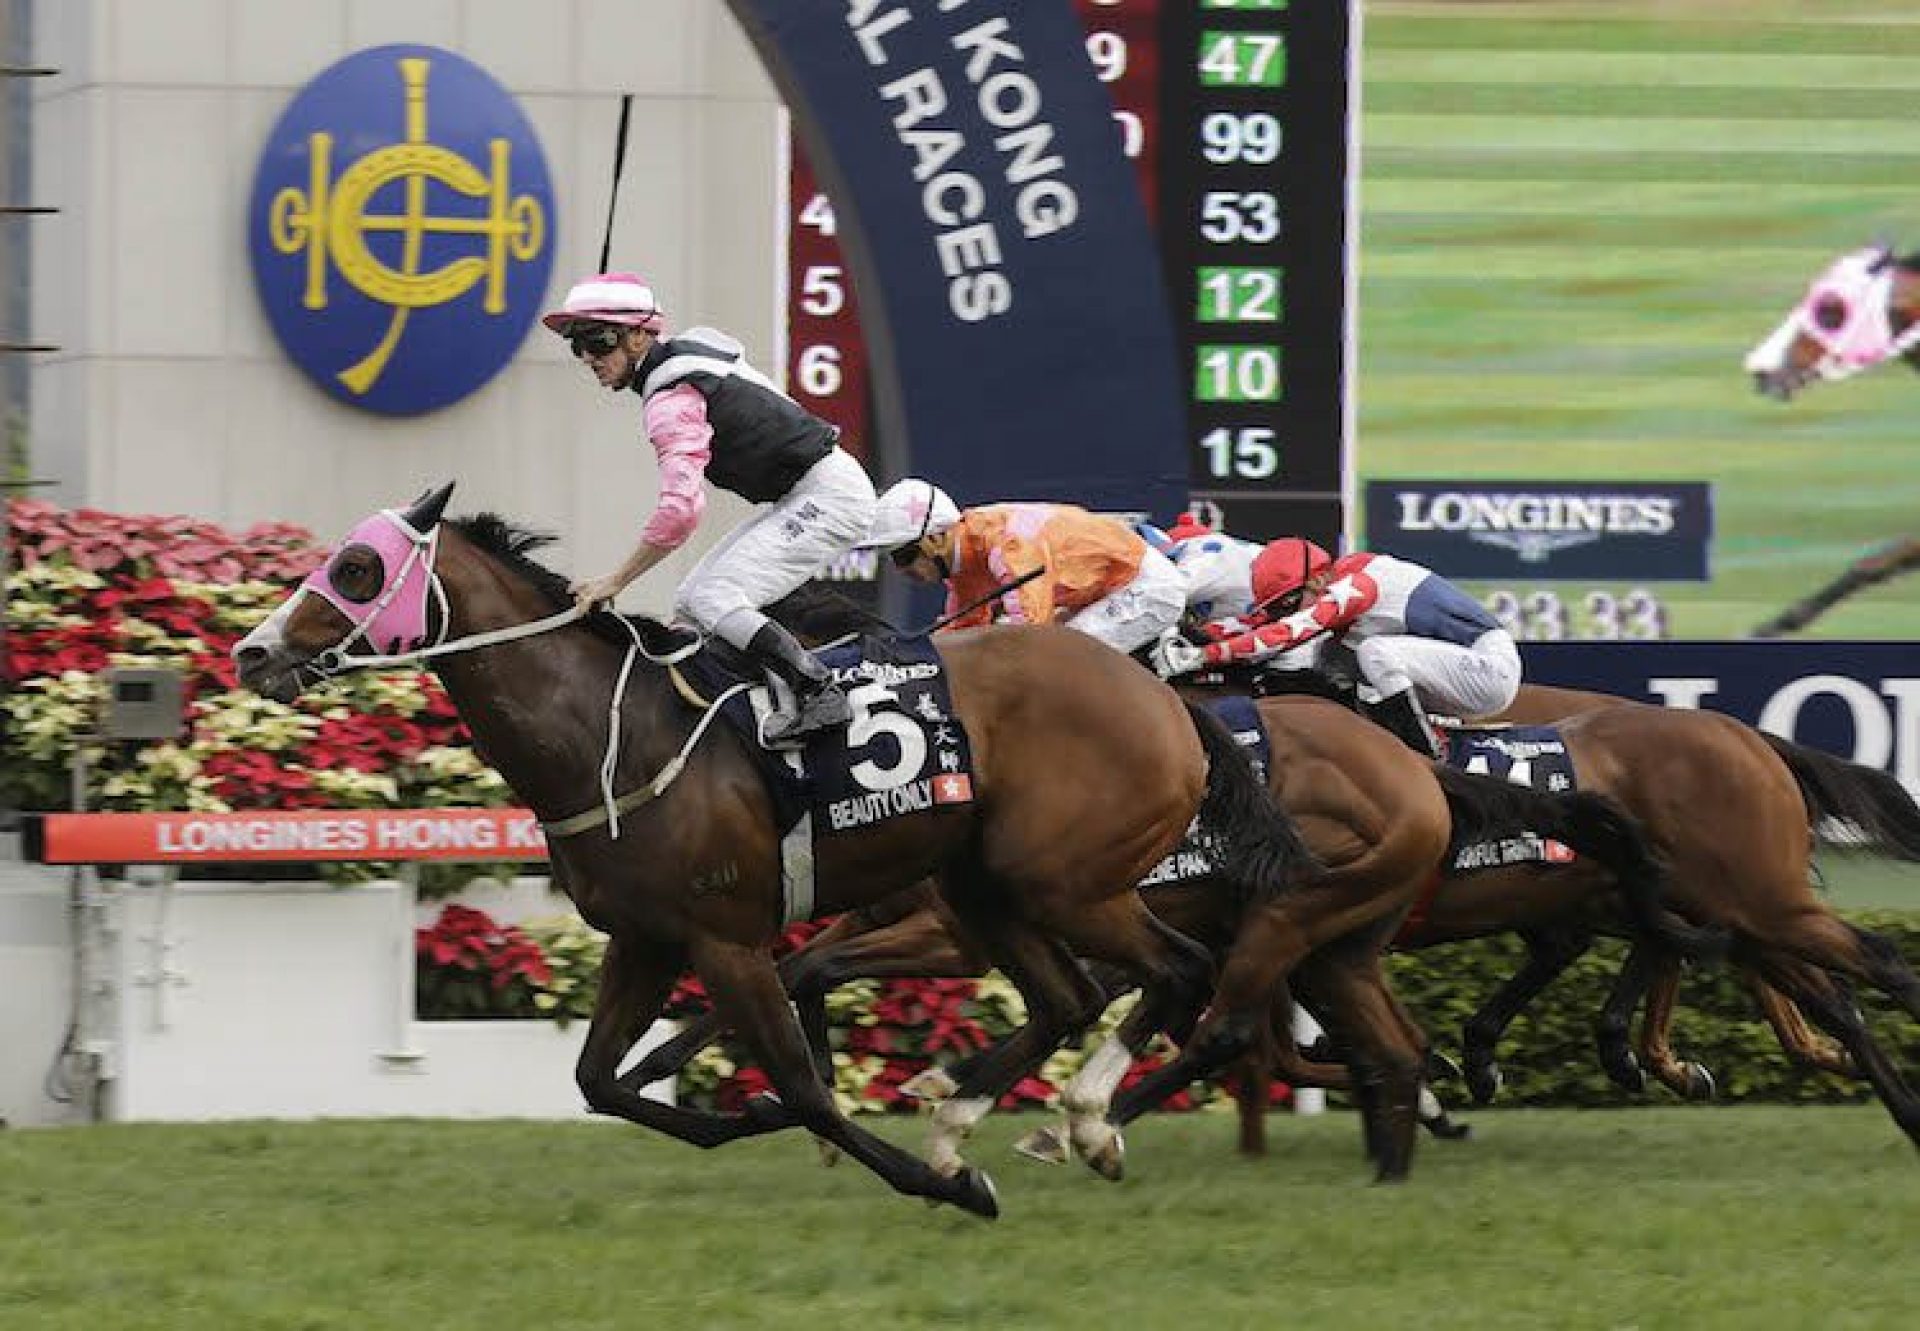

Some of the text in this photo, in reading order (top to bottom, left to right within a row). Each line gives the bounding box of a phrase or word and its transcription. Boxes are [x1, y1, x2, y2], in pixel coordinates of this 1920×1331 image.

[1085, 32, 1127, 82] 9
[1198, 35, 1284, 83] 47
[951, 17, 1079, 239] KONG
[1201, 112, 1282, 164] 99
[799, 194, 837, 237] 4
[878, 67, 1013, 323] RACES
[1201, 192, 1281, 244] 53
[802, 266, 845, 316] 5
[1203, 273, 1277, 321] 12
[799, 345, 842, 395] 6
[1202, 351, 1279, 400] 10
[1201, 430, 1278, 480] 15
[1395, 493, 1676, 534] LONGINES
[847, 683, 927, 790] 5
[829, 778, 934, 830] BEAUTY ONLY
[157, 820, 369, 853] LONGINES
[377, 818, 497, 850] HONG
